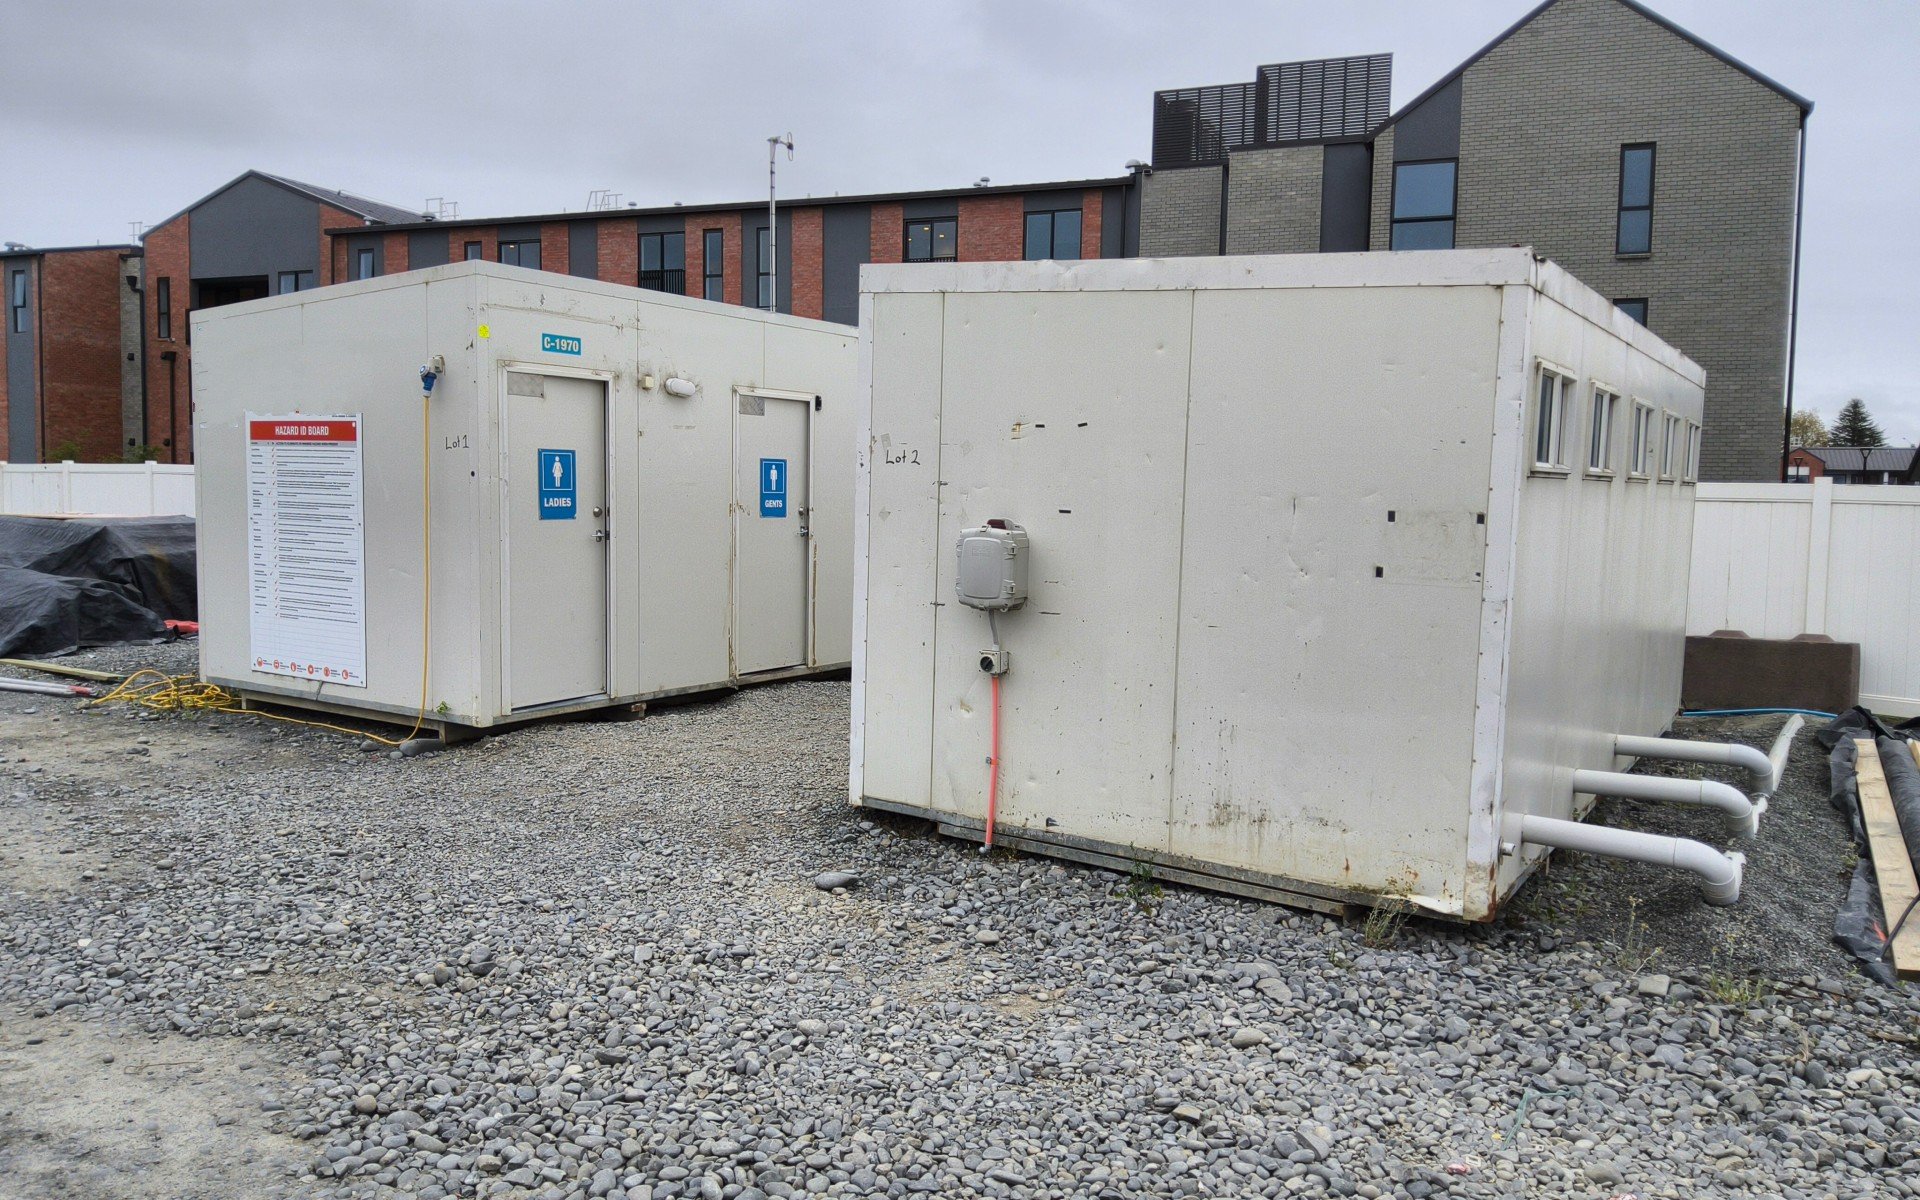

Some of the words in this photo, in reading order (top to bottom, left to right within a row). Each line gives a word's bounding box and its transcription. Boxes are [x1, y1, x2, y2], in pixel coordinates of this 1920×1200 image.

[544, 336, 580, 353] C-1970
[275, 425, 299, 436] HAZARD
[300, 425, 307, 436] ID
[308, 426, 329, 436] BOARD
[445, 435, 460, 450] Lot
[462, 434, 470, 449] 1
[885, 449, 907, 465] Lot
[911, 449, 921, 466] 2
[544, 497, 572, 507] LADIES
[764, 499, 783, 508] GENTS
